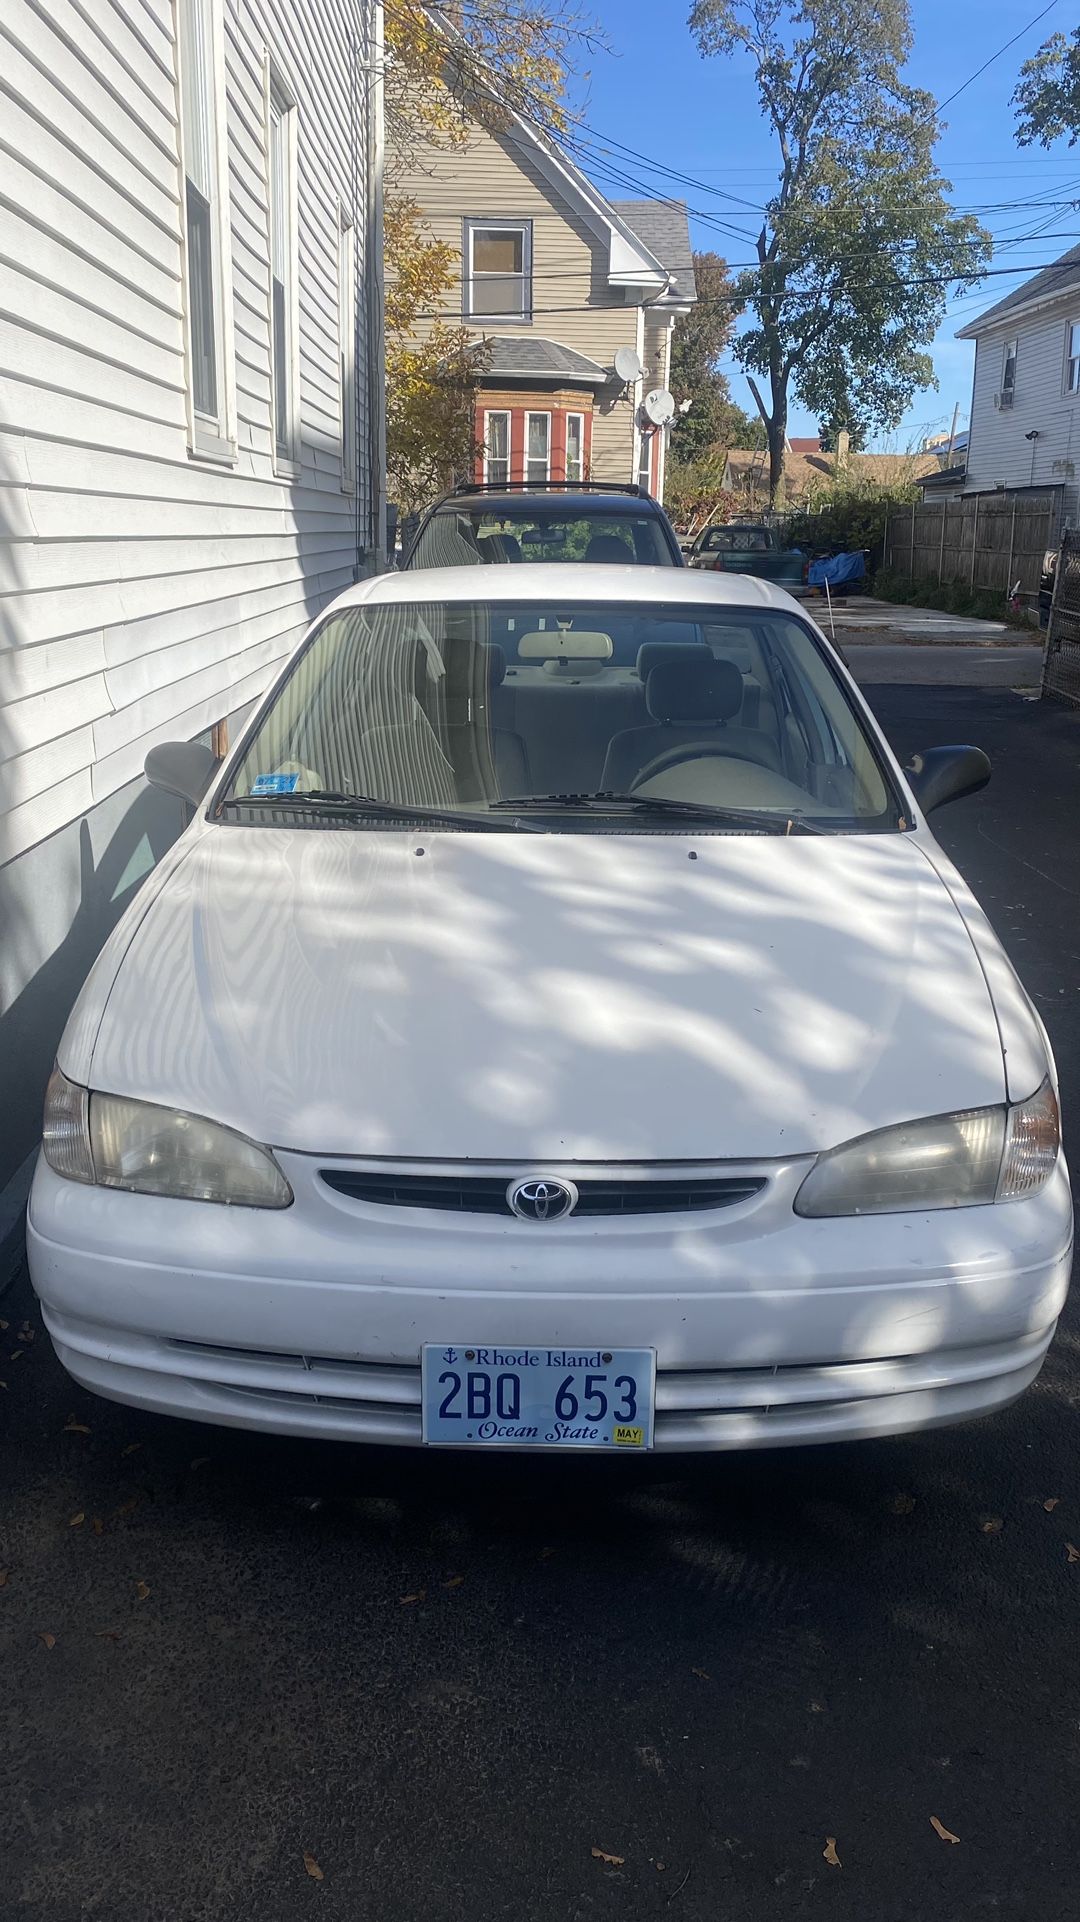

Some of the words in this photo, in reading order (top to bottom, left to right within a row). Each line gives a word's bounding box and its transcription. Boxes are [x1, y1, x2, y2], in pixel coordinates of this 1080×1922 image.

[476, 1349, 540, 1367] Rhode
[546, 1351, 602, 1368] Island
[438, 1371, 521, 1420] 2BQ
[554, 1374, 637, 1422] 653
[478, 1421, 538, 1439] Ocean
[545, 1422, 599, 1441] State
[617, 1428, 639, 1438] MAY
